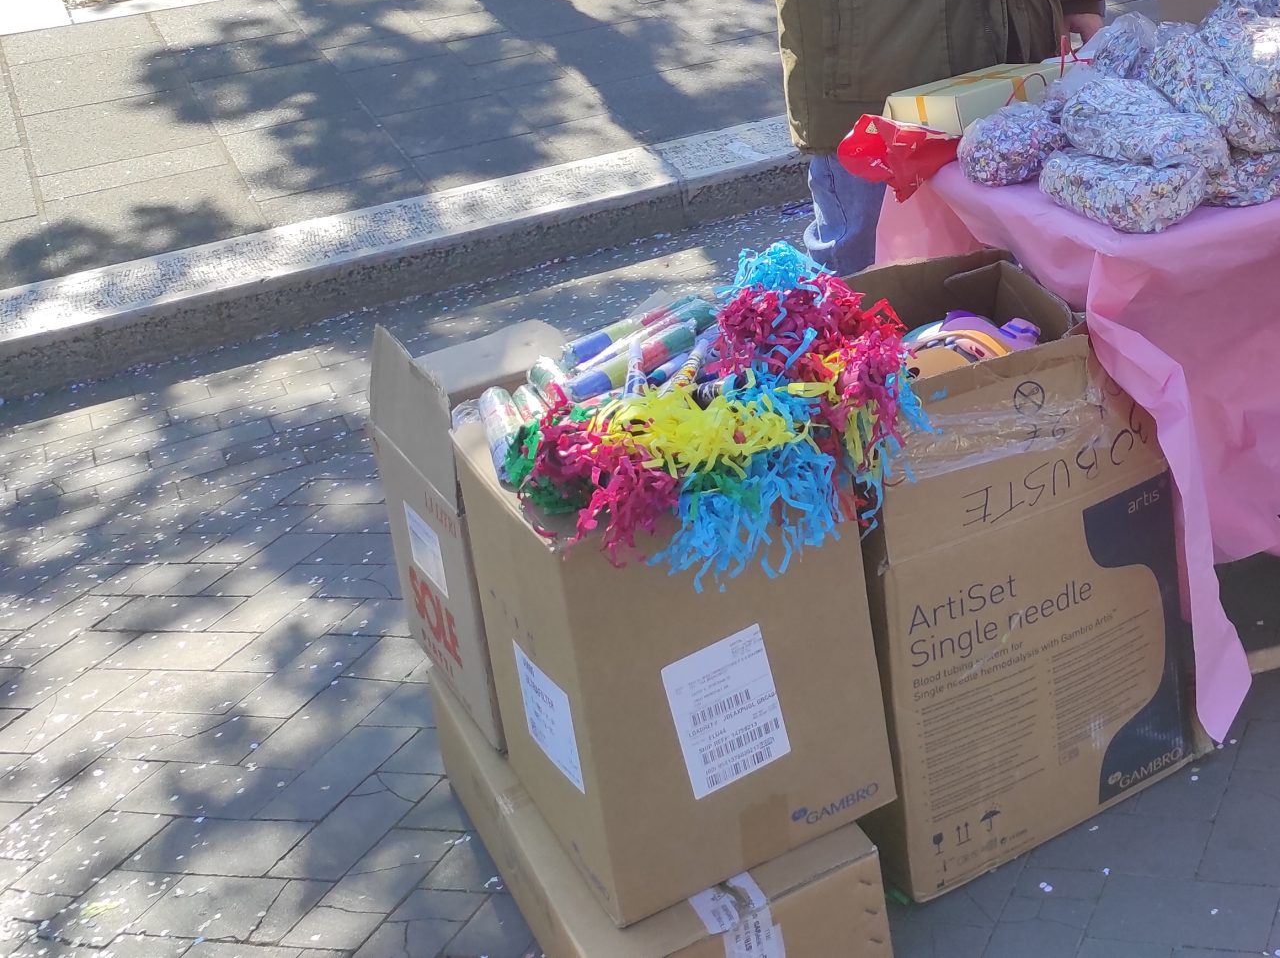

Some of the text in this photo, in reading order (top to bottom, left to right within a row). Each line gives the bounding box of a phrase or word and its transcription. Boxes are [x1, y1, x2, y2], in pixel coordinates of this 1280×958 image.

[962, 434, 1100, 527] BUSTE
[1127, 488, 1160, 515] artis
[908, 574, 1018, 635] ArtiSet
[909, 580, 1093, 668] Single needle
[912, 672, 941, 689] Blood
[943, 661, 974, 680] tubing
[1011, 642, 1025, 653] for
[914, 685, 944, 703] Single
[980, 649, 1040, 679] hemodialysis
[1041, 639, 1060, 652] with
[1061, 624, 1094, 644] Gambro
[1119, 747, 1185, 789] GAMBRO
[806, 782, 880, 824] GAMBRO
